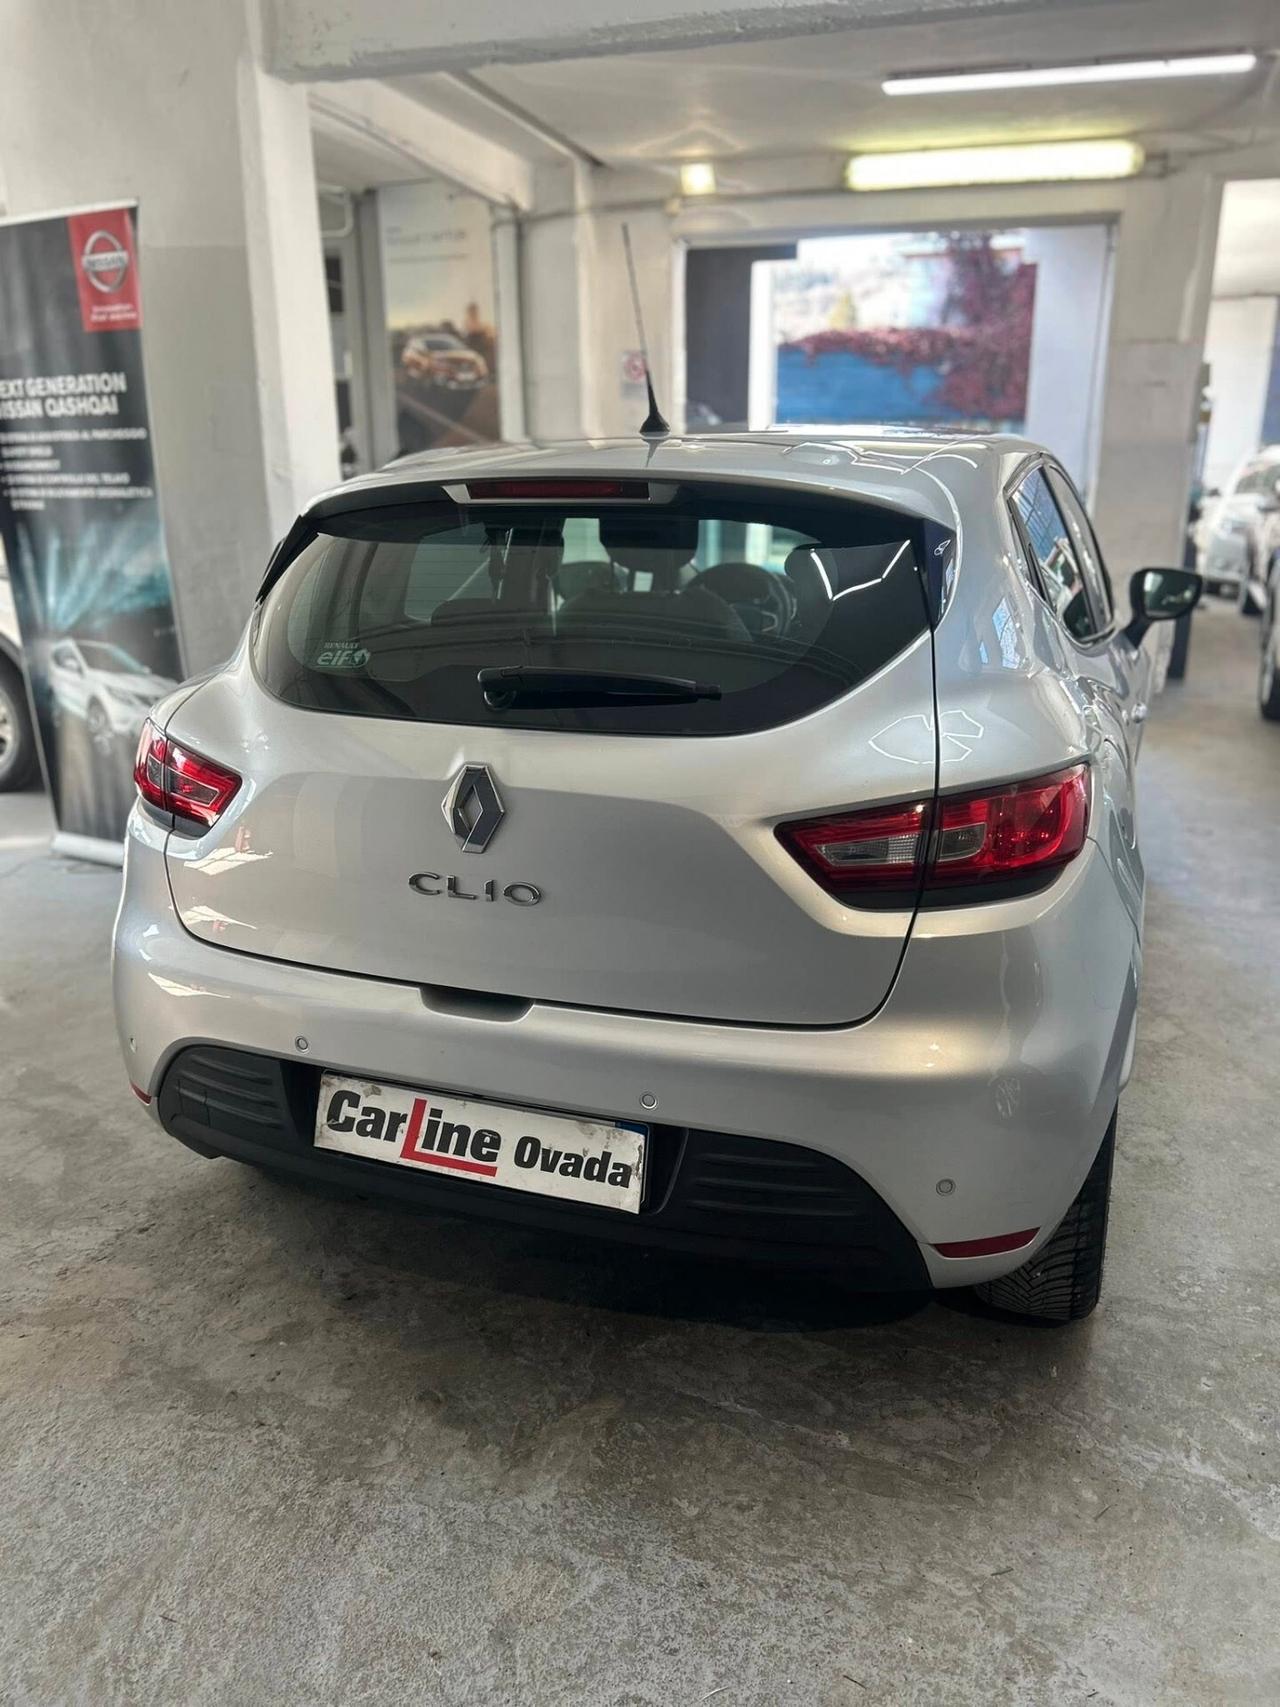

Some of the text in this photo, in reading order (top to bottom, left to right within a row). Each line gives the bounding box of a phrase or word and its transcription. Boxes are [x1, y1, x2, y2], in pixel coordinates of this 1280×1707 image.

[0, 372, 127, 397] EXT GENERATION
[408, 872, 542, 906] CLIO
[327, 1090, 633, 1188] CarLine Ovada
